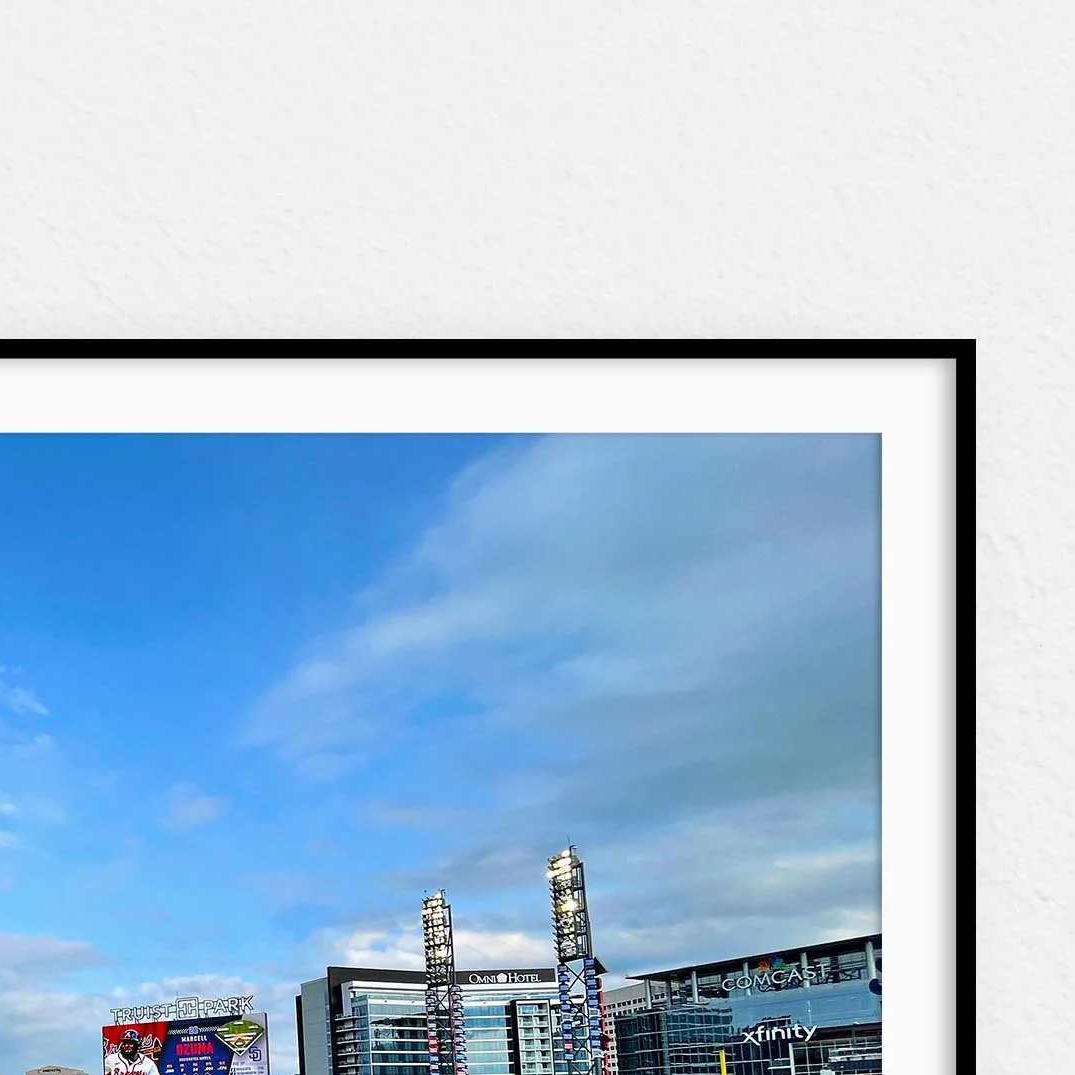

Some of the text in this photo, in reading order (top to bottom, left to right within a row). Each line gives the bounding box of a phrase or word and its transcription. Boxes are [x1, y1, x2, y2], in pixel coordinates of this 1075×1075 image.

[468, 972, 542, 984] OMNI HOTEL
[721, 964, 830, 991] COMCAST
[110, 995, 254, 1021] TRUIST PARK
[742, 1024, 818, 1046] xfinity
[176, 1042, 214, 1057] OZUNA
